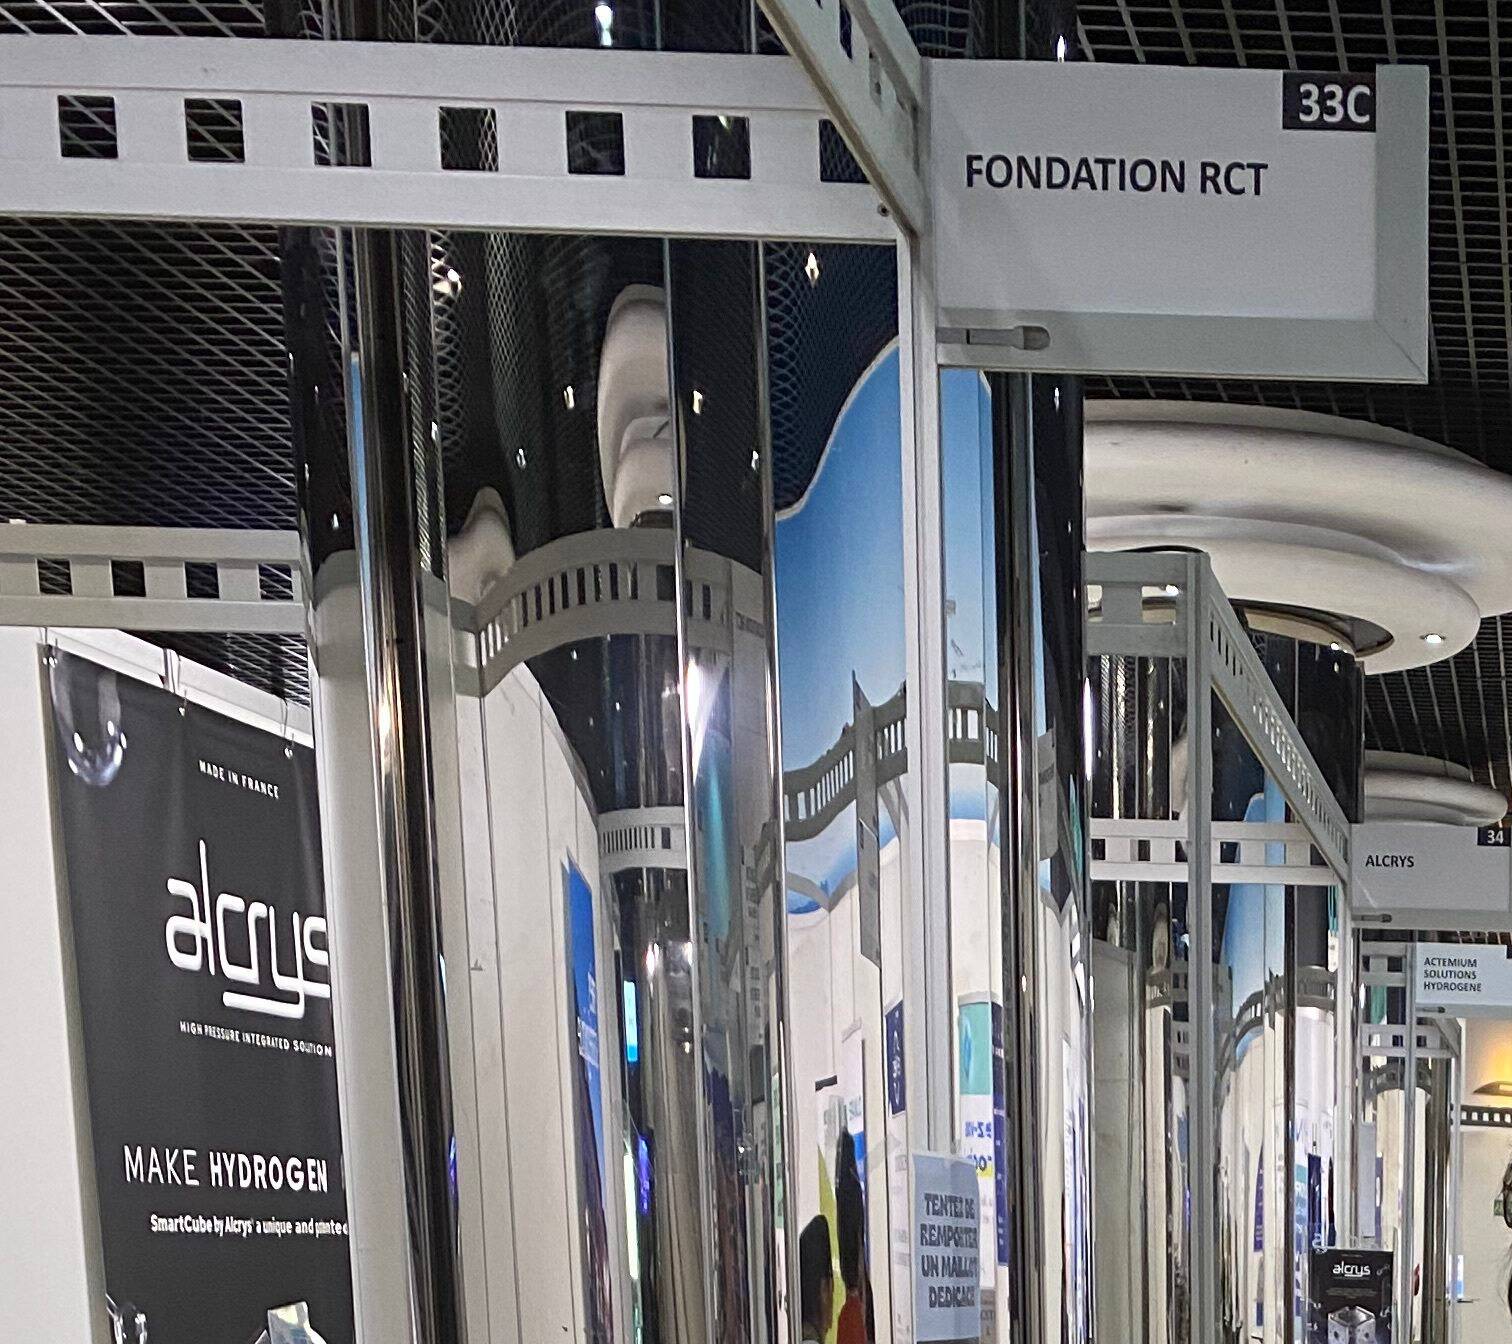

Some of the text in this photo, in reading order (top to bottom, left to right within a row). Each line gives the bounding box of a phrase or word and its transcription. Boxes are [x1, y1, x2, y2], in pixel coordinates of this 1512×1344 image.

[1299, 82, 1371, 124] 33C
[965, 154, 1269, 196] FONDATION RCT
[199, 760, 279, 799] MADE IN FRANCE
[1487, 831, 1504, 844] 34
[1365, 855, 1415, 868] ALCRYS
[166, 839, 331, 1019] alcrys
[1424, 957, 1477, 968] ACTEMIUM
[1424, 970, 1477, 980] SOLUTIONS
[1424, 981, 1482, 992] HYDROGENE
[180, 1021, 202, 1035] HIGH
[204, 1024, 239, 1042] PRESSURE
[242, 1030, 290, 1050] INTEGRATED
[124, 1145, 328, 1193] MAKE HYDROGEN
[151, 1214, 212, 1233] SmartCube
[295, 1219, 314, 1234] and
[921, 1254, 939, 1278] UN
[1333, 1261, 1371, 1277] alcrys
